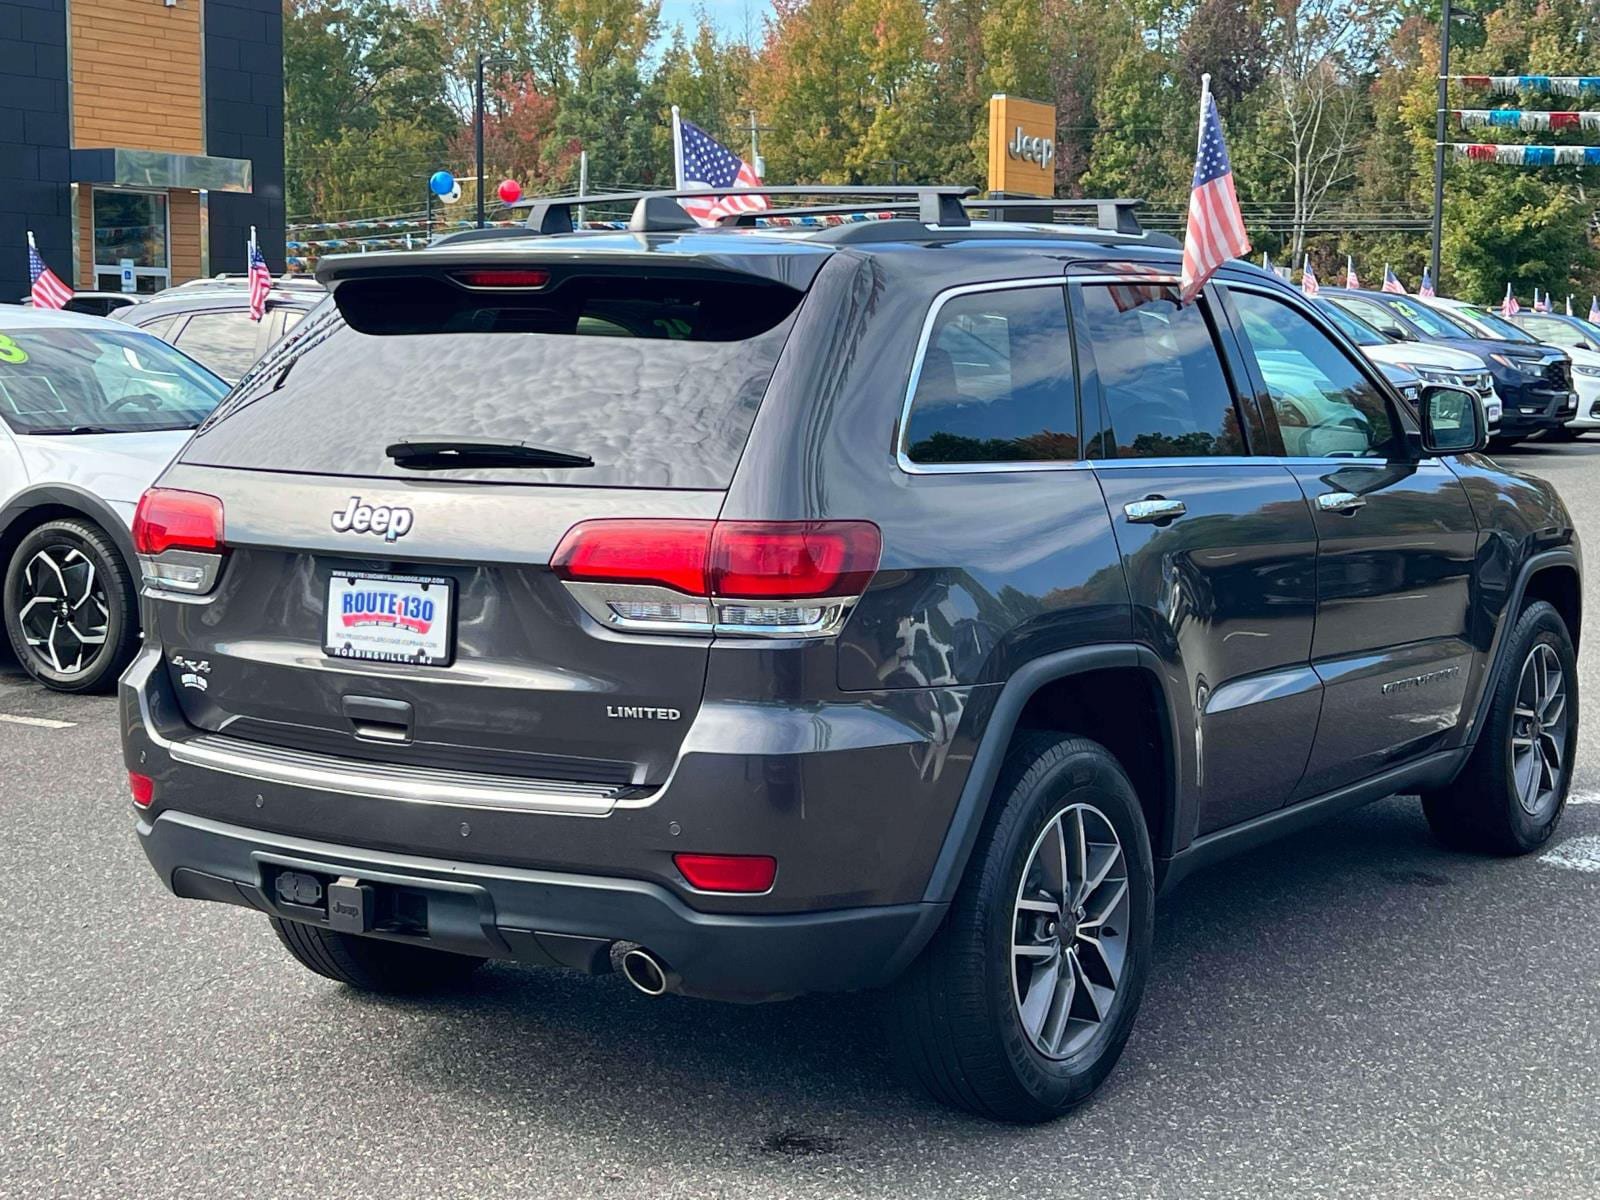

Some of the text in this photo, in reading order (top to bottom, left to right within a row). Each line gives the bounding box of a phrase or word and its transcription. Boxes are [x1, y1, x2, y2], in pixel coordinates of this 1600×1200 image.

[1008, 126, 1054, 170] Jeep
[331, 496, 414, 543] Jeep
[343, 592, 434, 621] ROUTE 130
[419, 655, 433, 665] NJ
[606, 705, 681, 720] LIMITED
